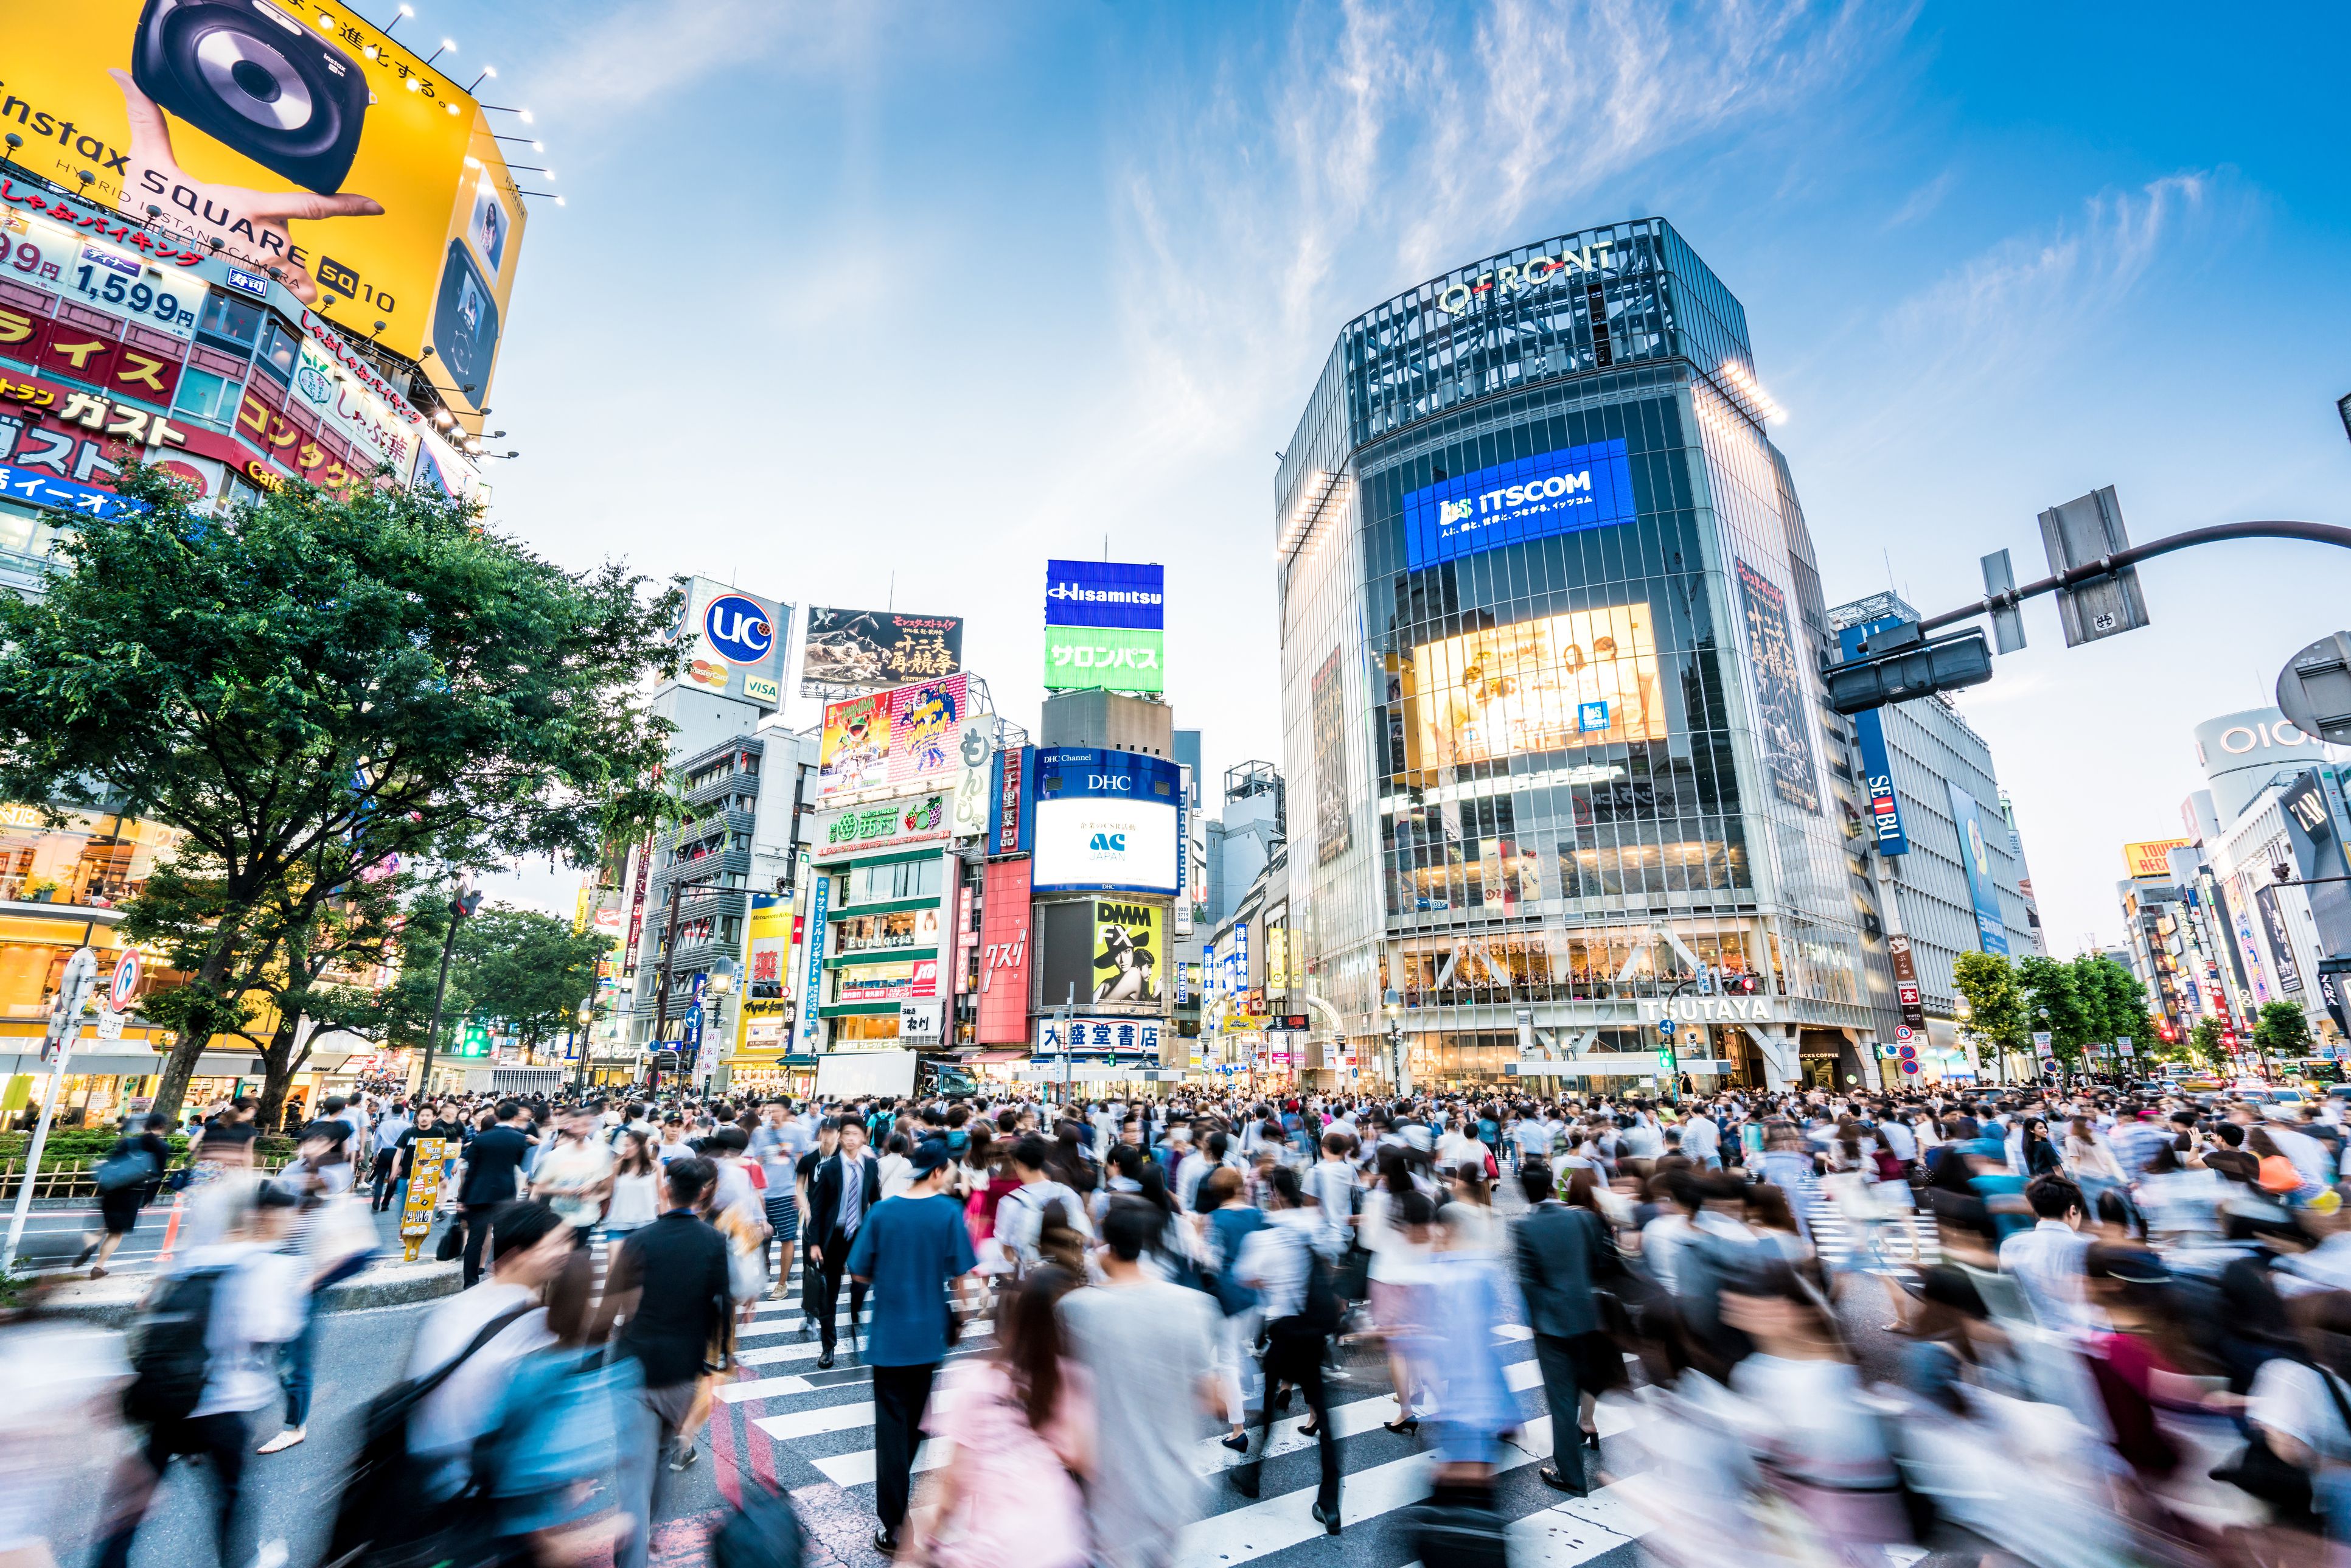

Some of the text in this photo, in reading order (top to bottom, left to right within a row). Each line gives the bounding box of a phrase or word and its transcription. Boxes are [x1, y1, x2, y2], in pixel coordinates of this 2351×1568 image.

[287, 0, 446, 108] で進化する。
[323, 52, 346, 72] instax
[0, 80, 131, 177] nstax
[506, 176, 524, 218] FUJIFILM
[1, 179, 205, 267] しゃぶバイキング
[56, 159, 131, 203] HYRID
[229, 246, 300, 289] CAMRA
[139, 169, 309, 269] SQUARE
[88, 248, 137, 271] ディナー
[231, 273, 265, 293] 寿司
[1438, 240, 1614, 316] QFRONT
[77, 264, 195, 328] 1,599円
[302, 309, 422, 425] しゃぶしゃぶバイキング
[60, 392, 186, 447] ガスト
[336, 388, 408, 464] しゃぶ葉
[1552, 495, 1593, 510] イッツコム
[1047, 582, 1162, 605] Hisamitsu
[892, 615, 956, 632] モンスターストライク
[894, 634, 952, 655] 十二支
[1051, 644, 1158, 670] サロンパス
[886, 650, 959, 676] 再競争
[749, 681, 776, 697] VISA
[912, 699, 944, 726] WANIMA
[905, 721, 928, 752] Gotta
[2221, 720, 2318, 754] OIO
[1061, 753, 1092, 762] Channel
[956, 727, 991, 831] もんじゃ
[1087, 774, 1132, 792] DHC
[1000, 751, 1019, 847] 三千里薬品
[1868, 775, 1900, 841] SEIBU
[859, 807, 899, 818] FRUITS&PARLOR
[859, 815, 897, 838] 西村
[1089, 833, 1125, 851] AC
[1089, 852, 1125, 862] JAPAN
[2139, 857, 2170, 873] REC
[1098, 902, 1152, 927] DMM
[2175, 901, 2195, 947] KARAOKE
[812, 896, 826, 976] サマーフルーツギフト
[848, 935, 911, 950] Euphoria
[1097, 924, 1134, 947] FX
[1582, 933, 1659, 949] COFFEE
[754, 950, 778, 980] 薬
[981, 928, 1028, 994] クスリ
[1236, 927, 1248, 987] 洋服の青山
[735, 965, 745, 992] 渋谷駅前
[914, 963, 936, 982] JTB
[1204, 952, 1214, 1004] 洋服の青
[1699, 964, 1710, 991] 渋谷駅前
[1902, 989, 1917, 1002] 本
[2319, 974, 2339, 1006] ZARA
[907, 1016, 930, 1031] 松川
[1642, 999, 1771, 1022] TSUTAYA
[99, 1022, 124, 1039] ここまで
[1043, 1023, 1158, 1048] 大盛堂書店
[704, 1033, 715, 1070] 道玄坂
